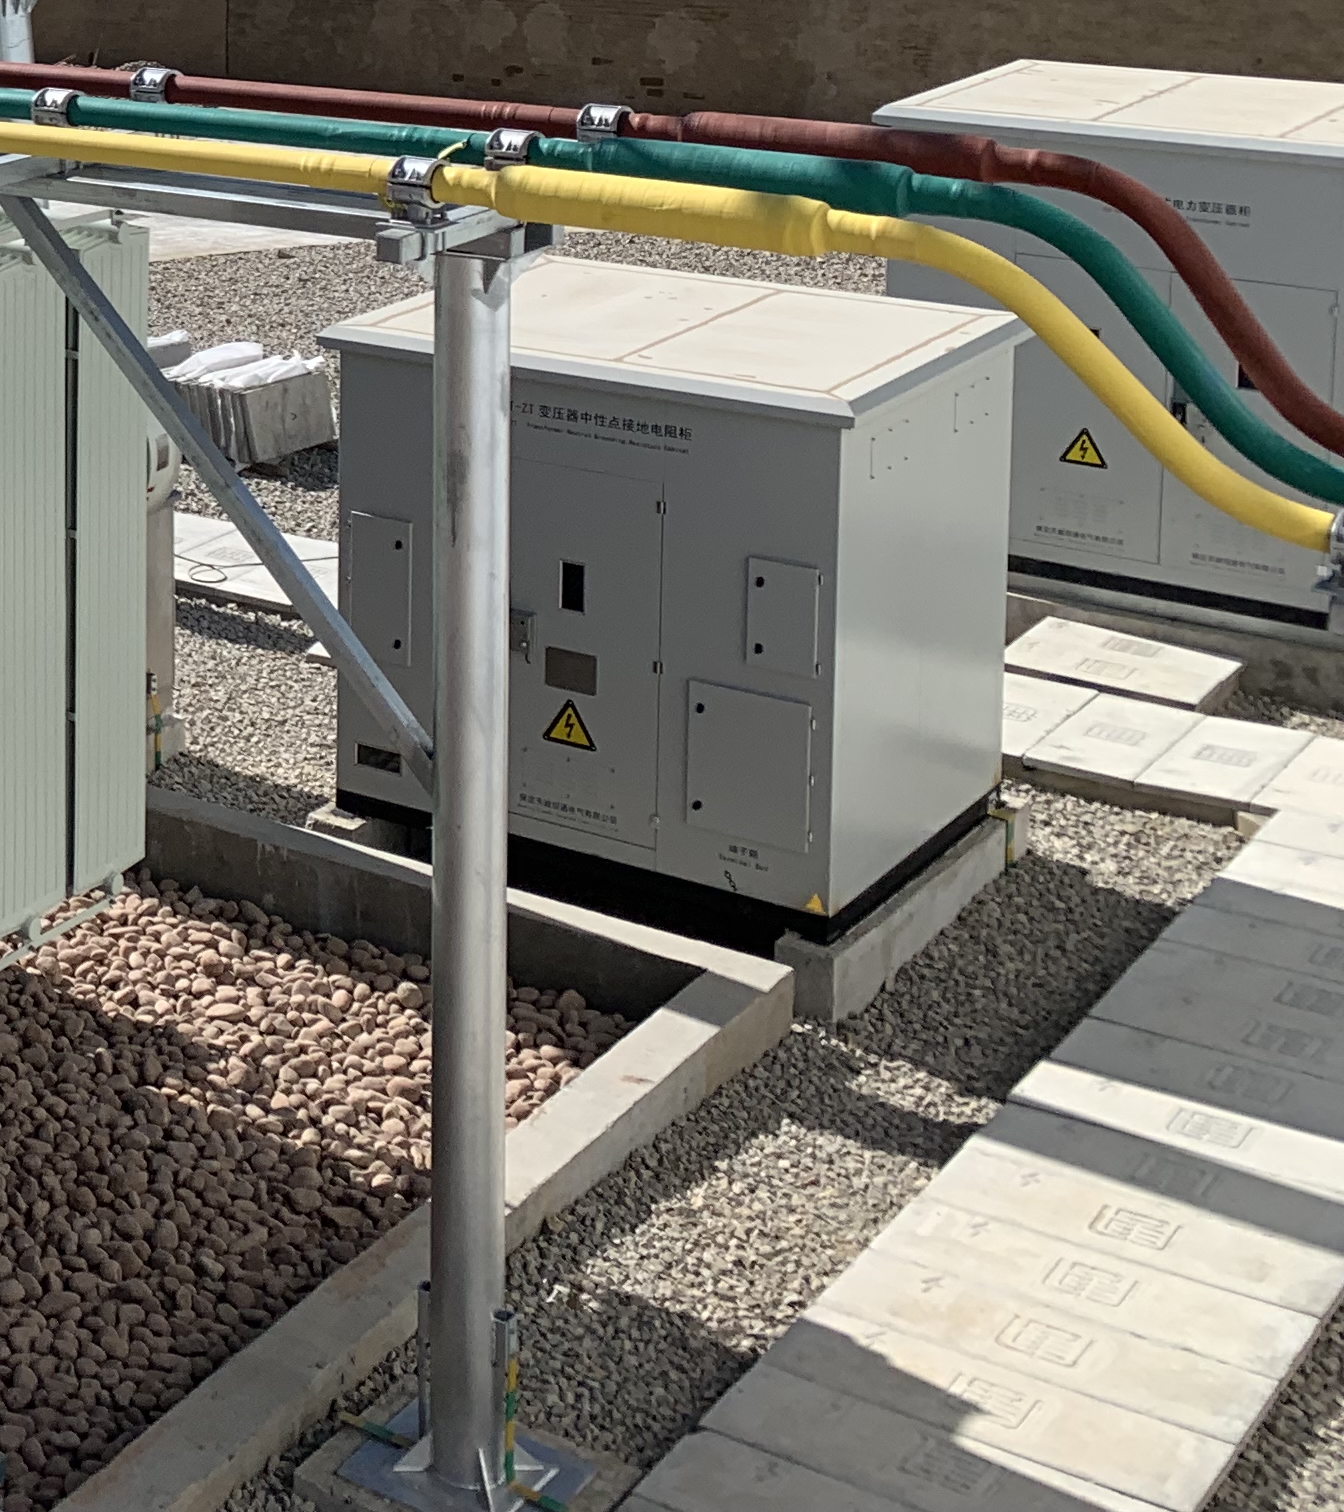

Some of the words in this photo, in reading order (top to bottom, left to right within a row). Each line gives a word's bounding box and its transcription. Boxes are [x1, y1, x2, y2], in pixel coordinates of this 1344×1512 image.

[538, 404, 693, 442] 变压器中性点接地电阻柜
